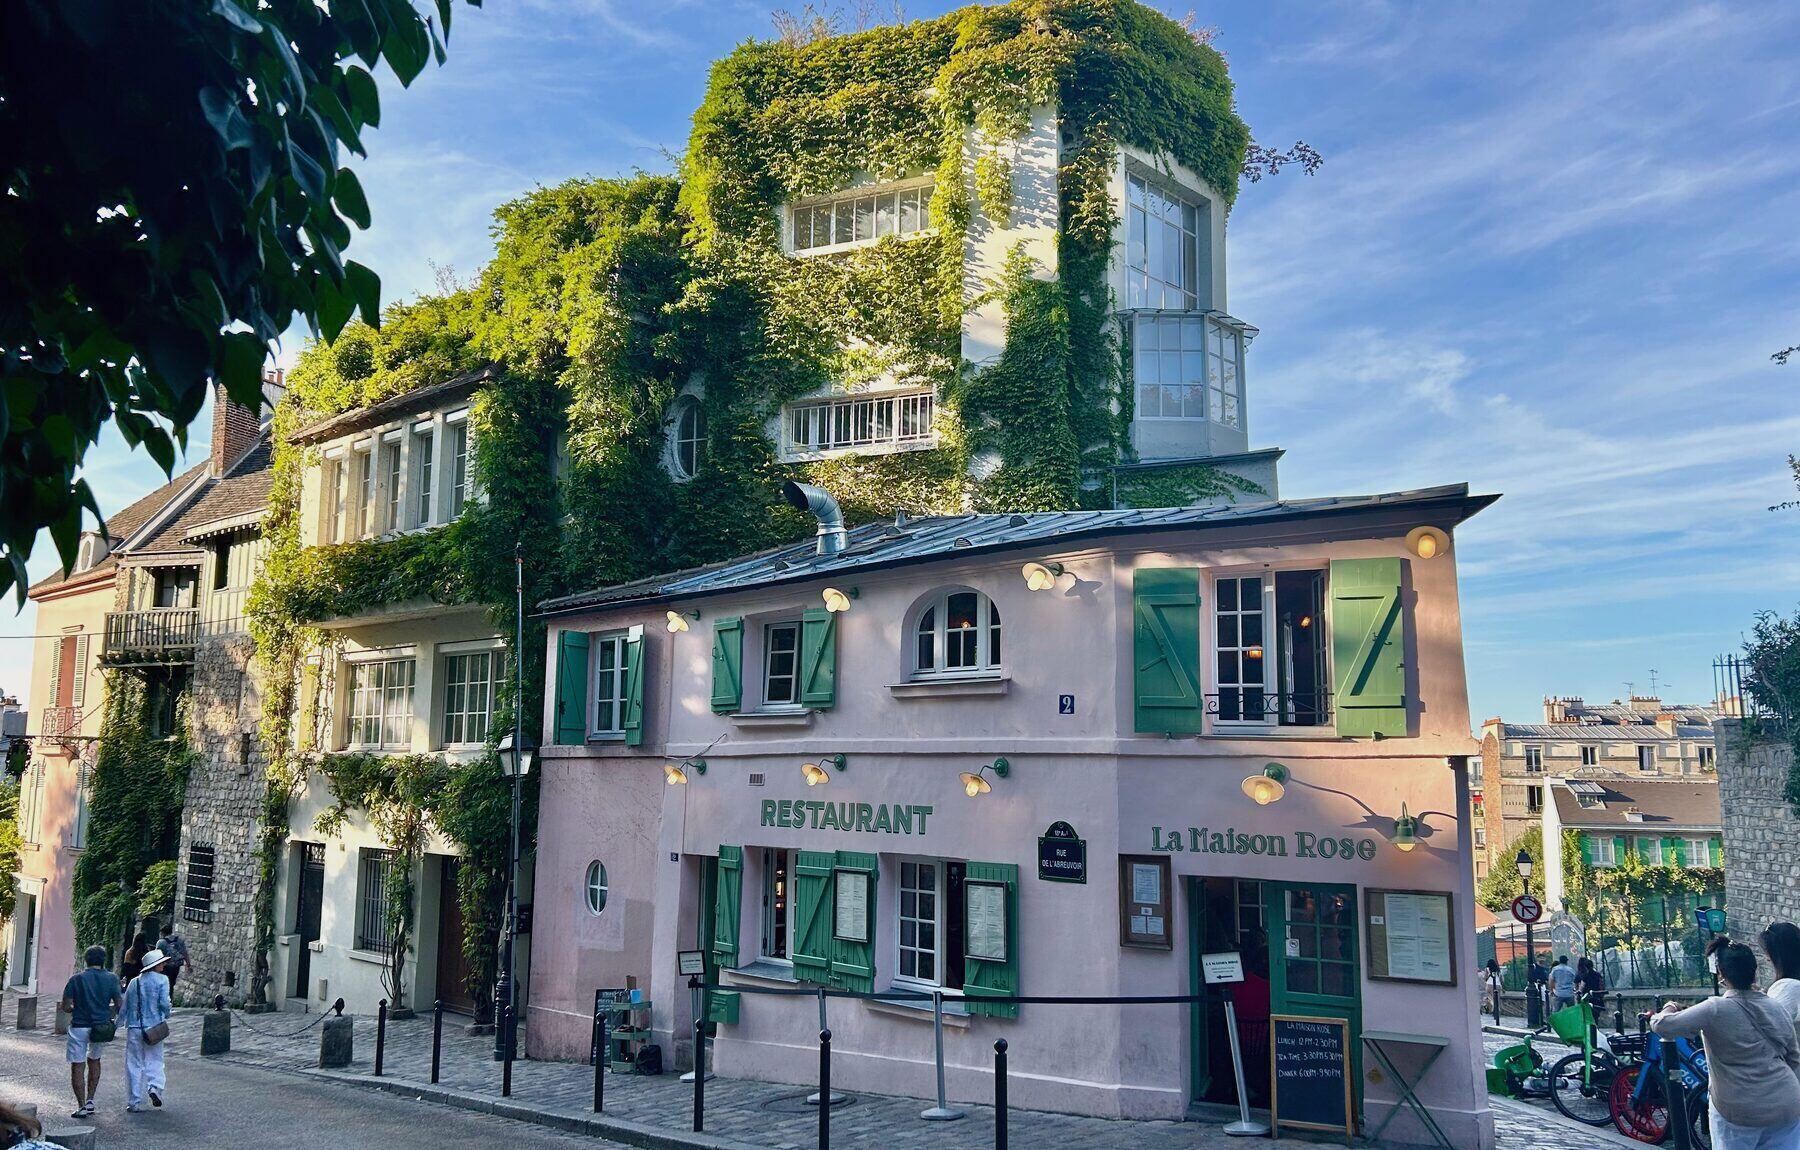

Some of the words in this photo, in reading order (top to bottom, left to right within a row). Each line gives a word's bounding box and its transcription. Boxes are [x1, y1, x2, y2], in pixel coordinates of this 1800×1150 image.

[1062, 696, 1072, 713] 2
[760, 799, 934, 835] RESTAURANT
[1151, 826, 1184, 852] La
[1188, 827, 1289, 857] Maison
[1294, 831, 1377, 861] Rose
[1056, 849, 1067, 857] RUE
[1042, 859, 1050, 868] DE
[1050, 860, 1083, 870] L'ABREUVOIR
